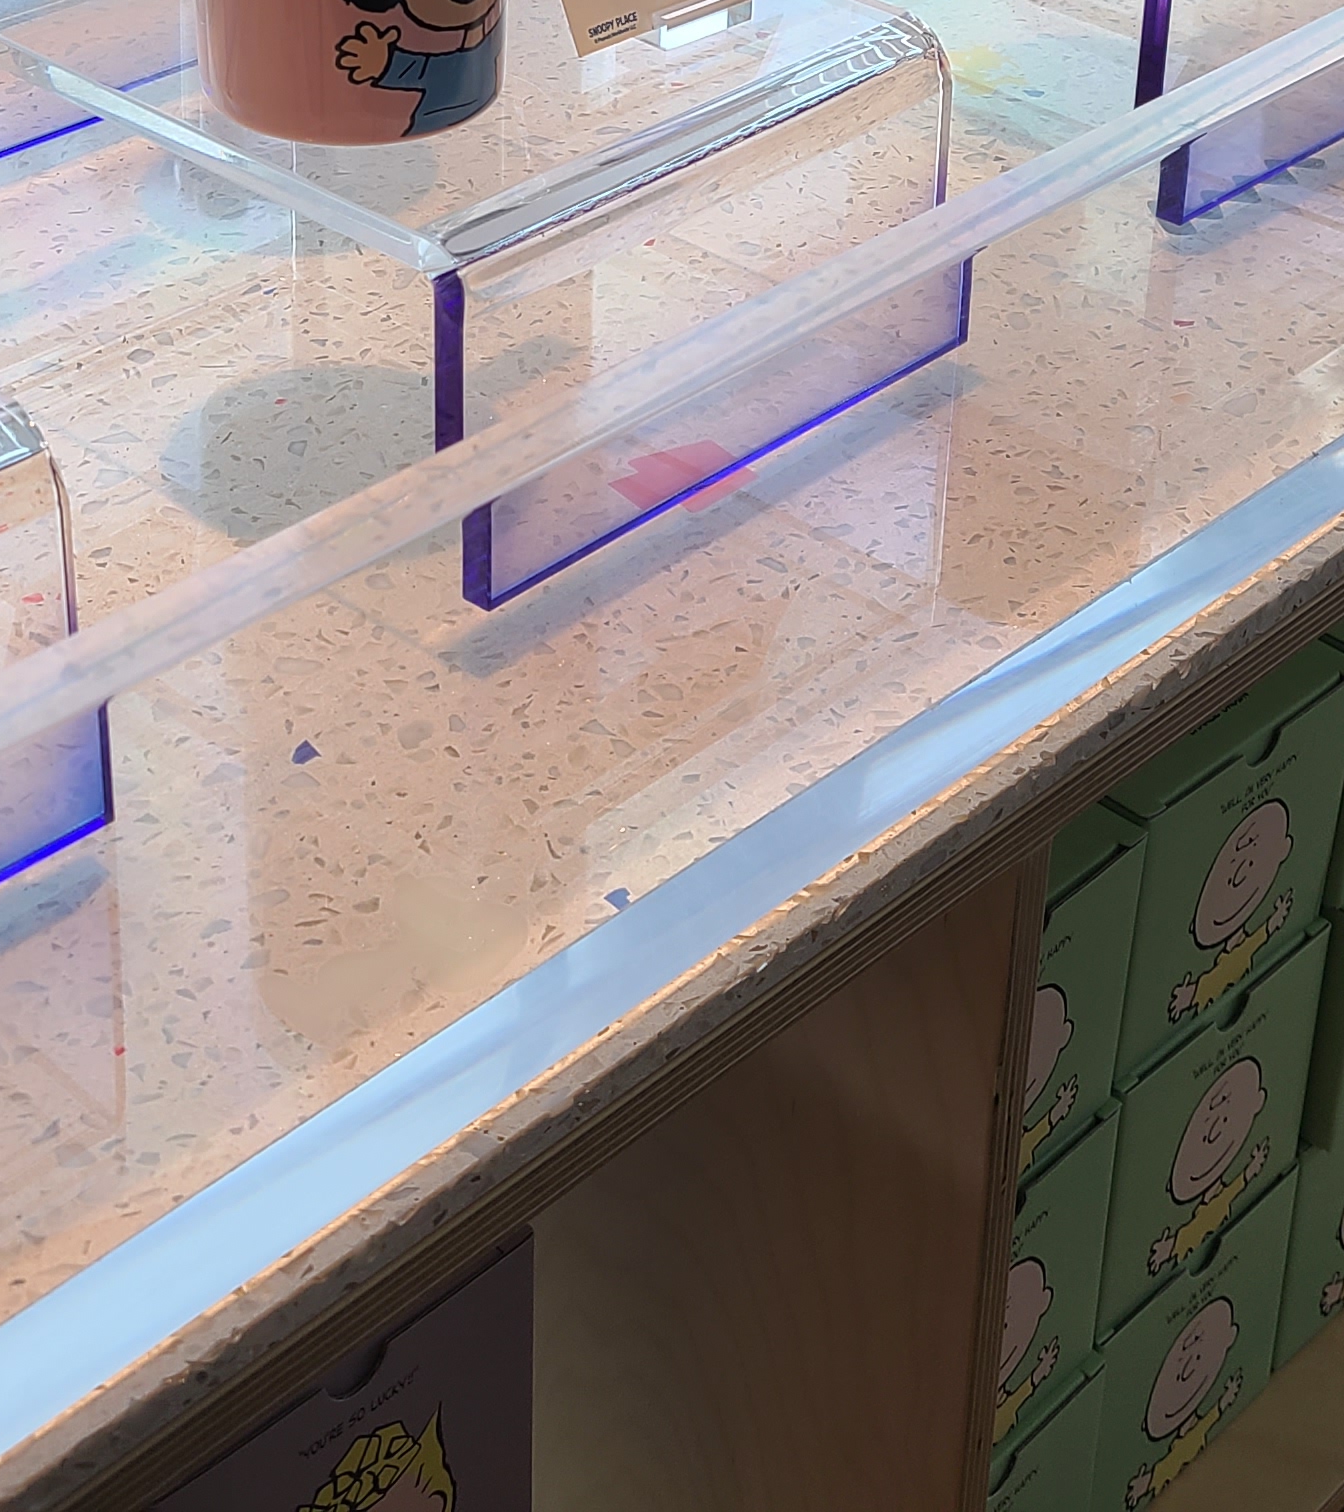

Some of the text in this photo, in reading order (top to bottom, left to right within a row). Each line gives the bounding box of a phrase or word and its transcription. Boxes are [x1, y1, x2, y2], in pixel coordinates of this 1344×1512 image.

[587, 11, 638, 38] SNOOPY PLACE
[347, 1406, 367, 1429] SO
